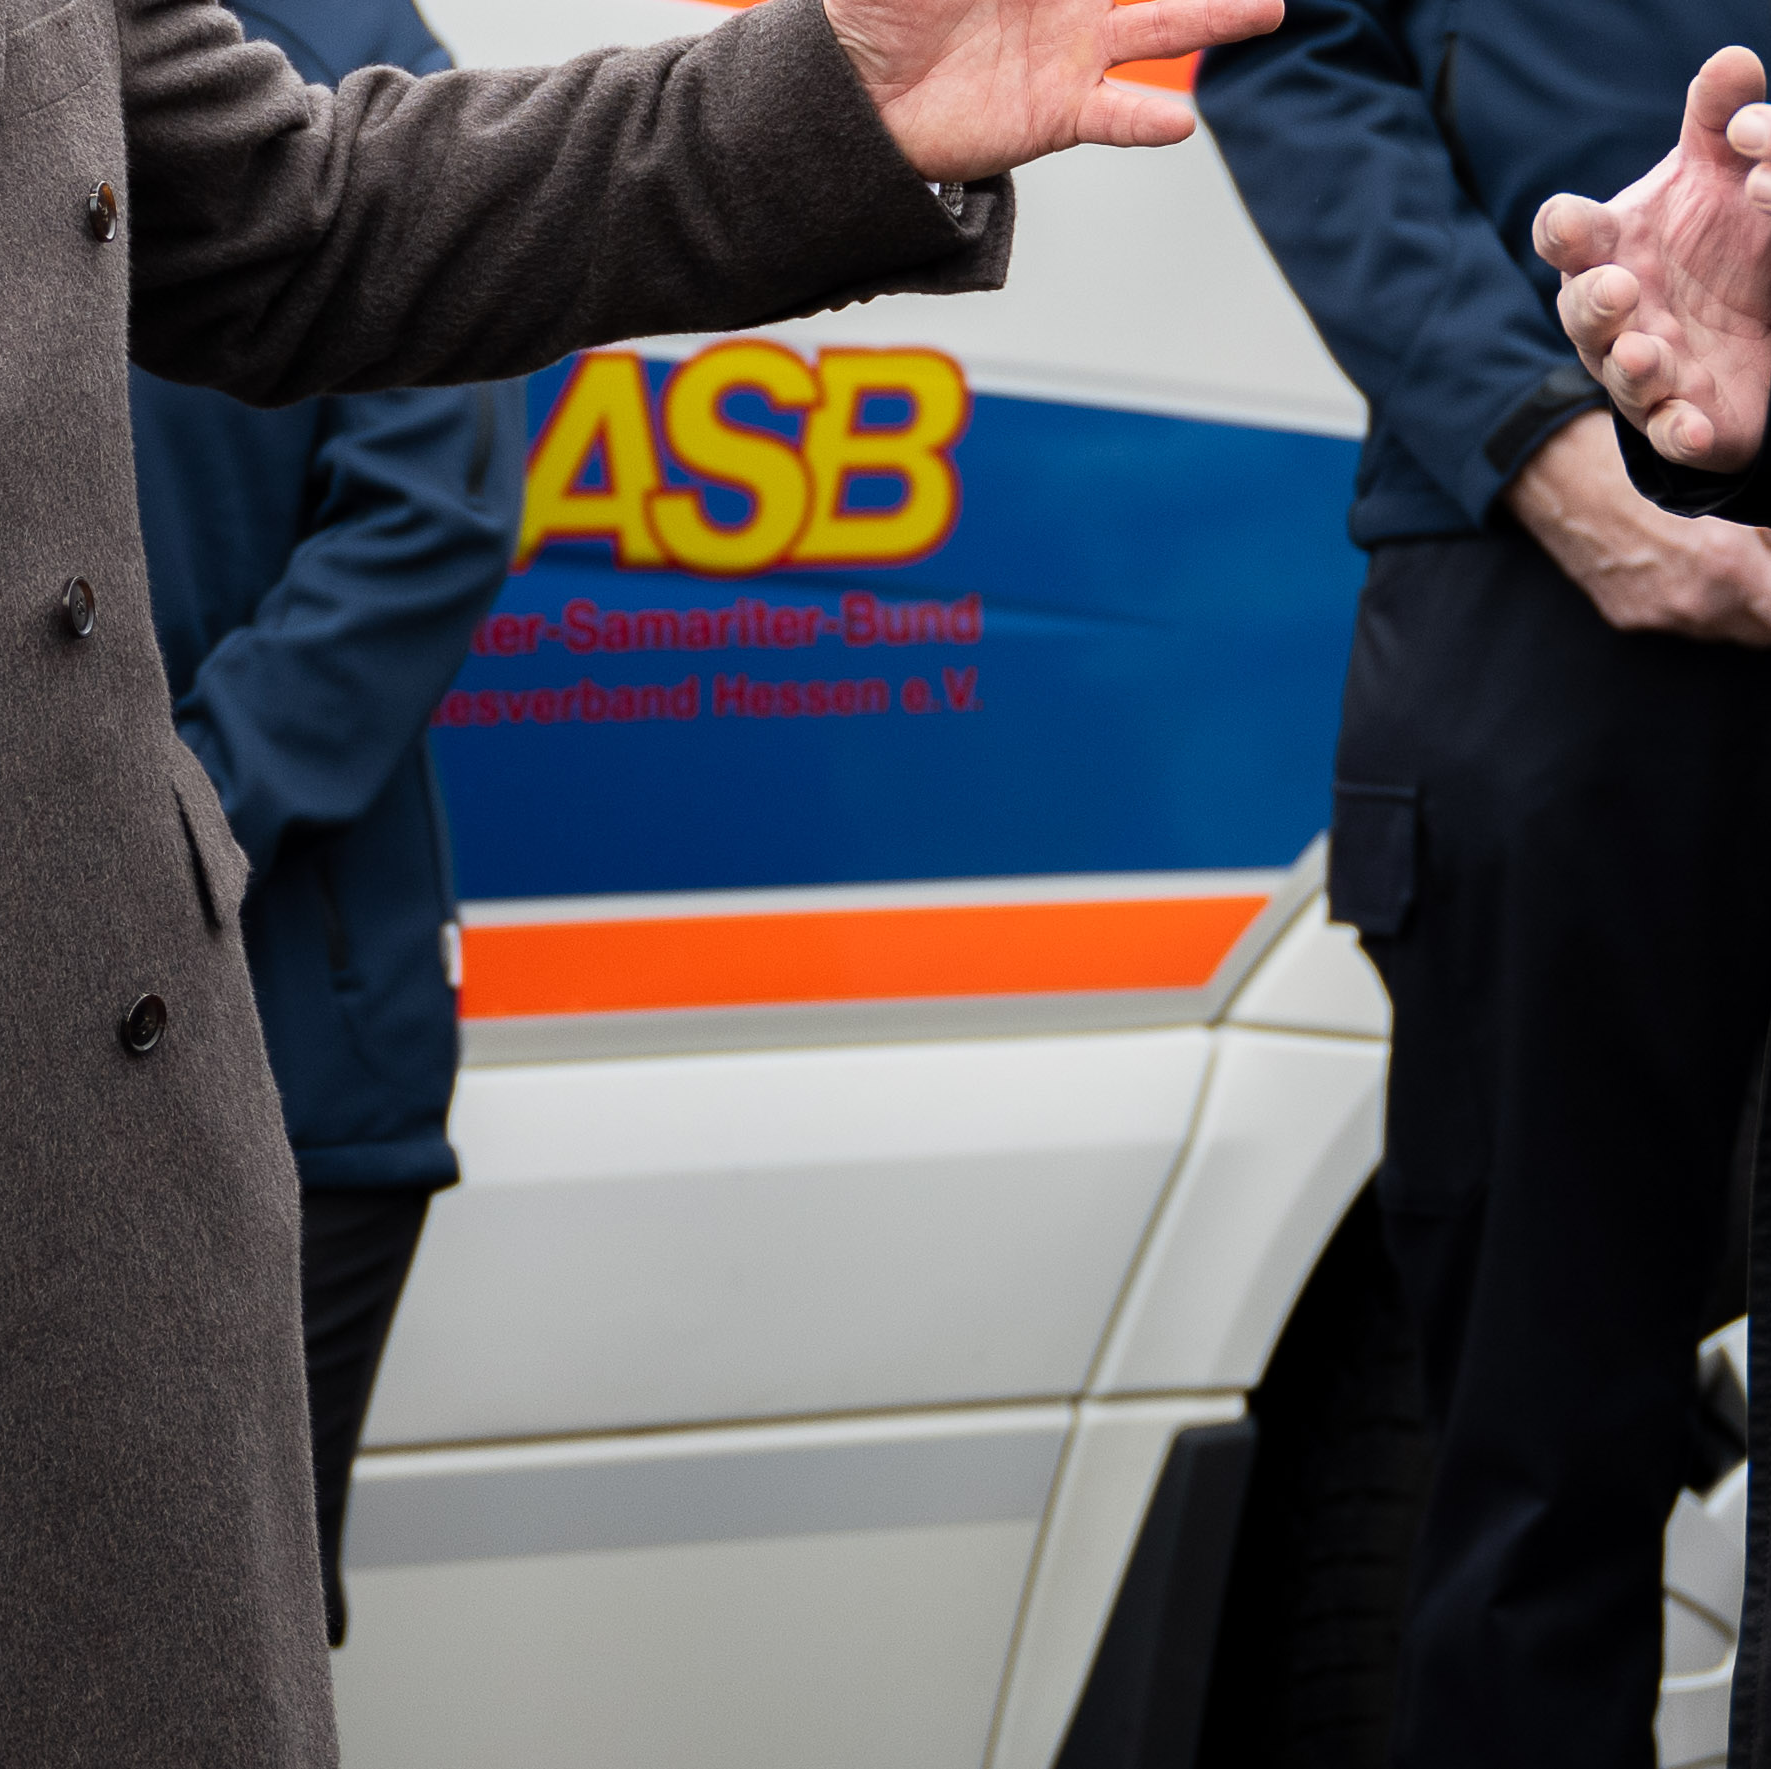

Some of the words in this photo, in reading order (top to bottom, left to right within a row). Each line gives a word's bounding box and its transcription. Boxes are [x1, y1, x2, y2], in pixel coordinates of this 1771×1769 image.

[509, 337, 973, 580] ASB
[429, 673, 701, 728] esverband
[712, 671, 891, 718] Hessen
